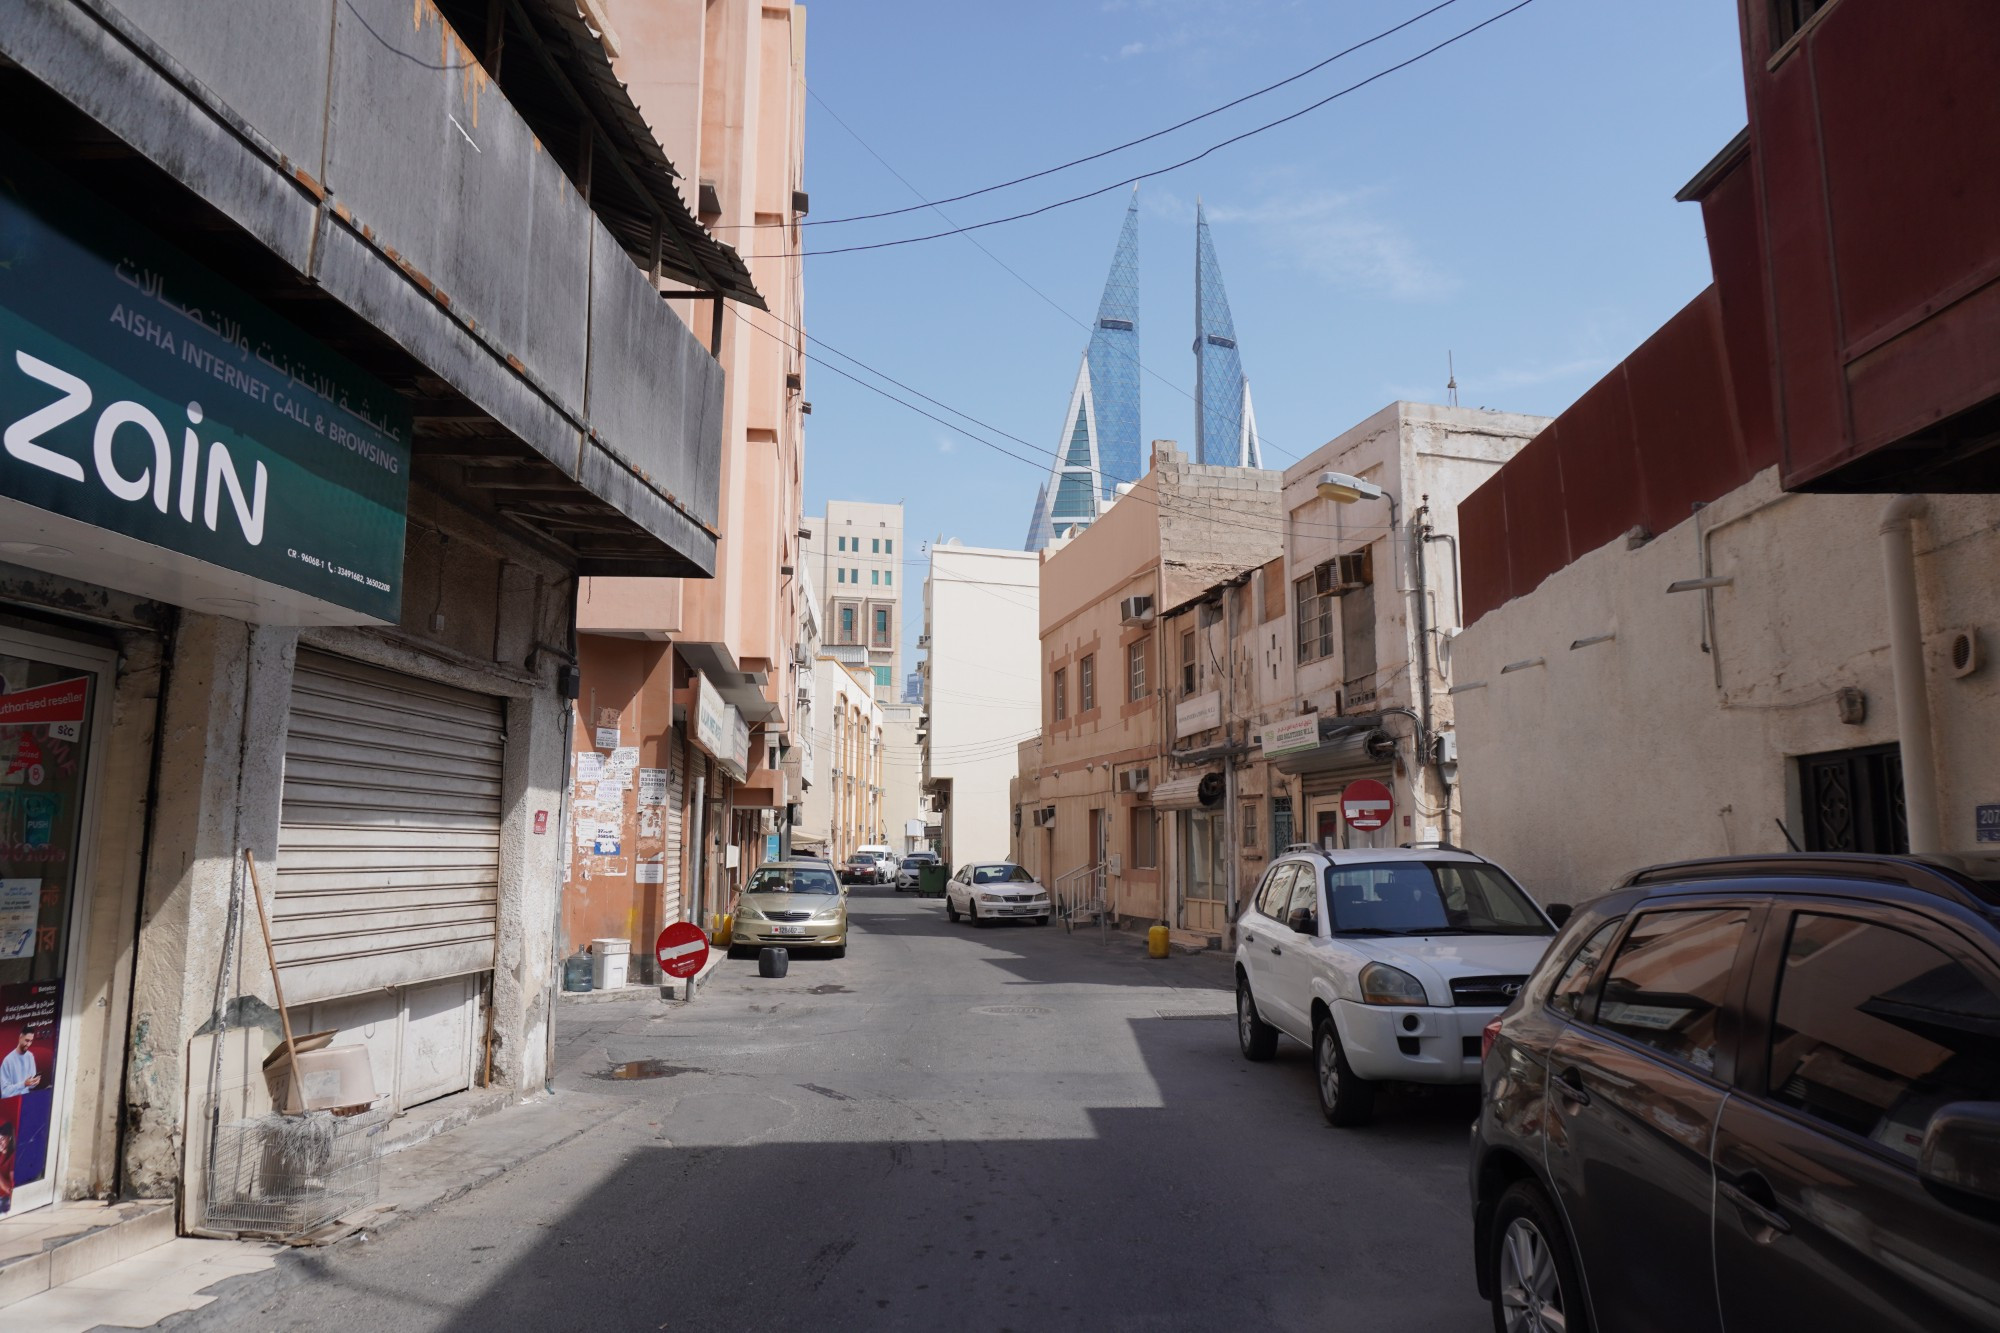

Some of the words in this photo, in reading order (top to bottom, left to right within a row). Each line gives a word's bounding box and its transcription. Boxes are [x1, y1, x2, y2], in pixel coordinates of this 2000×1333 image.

[115, 257, 250, 362] والاتصالات
[110, 304, 175, 355] AISHA
[182, 339, 270, 403] INTERNET
[273, 392, 311, 428] CALL
[315, 415, 326, 434] &
[329, 422, 400, 474] BROWSING
[48, 693, 83, 706] reseller
[27, 820, 49, 829] PUSH
